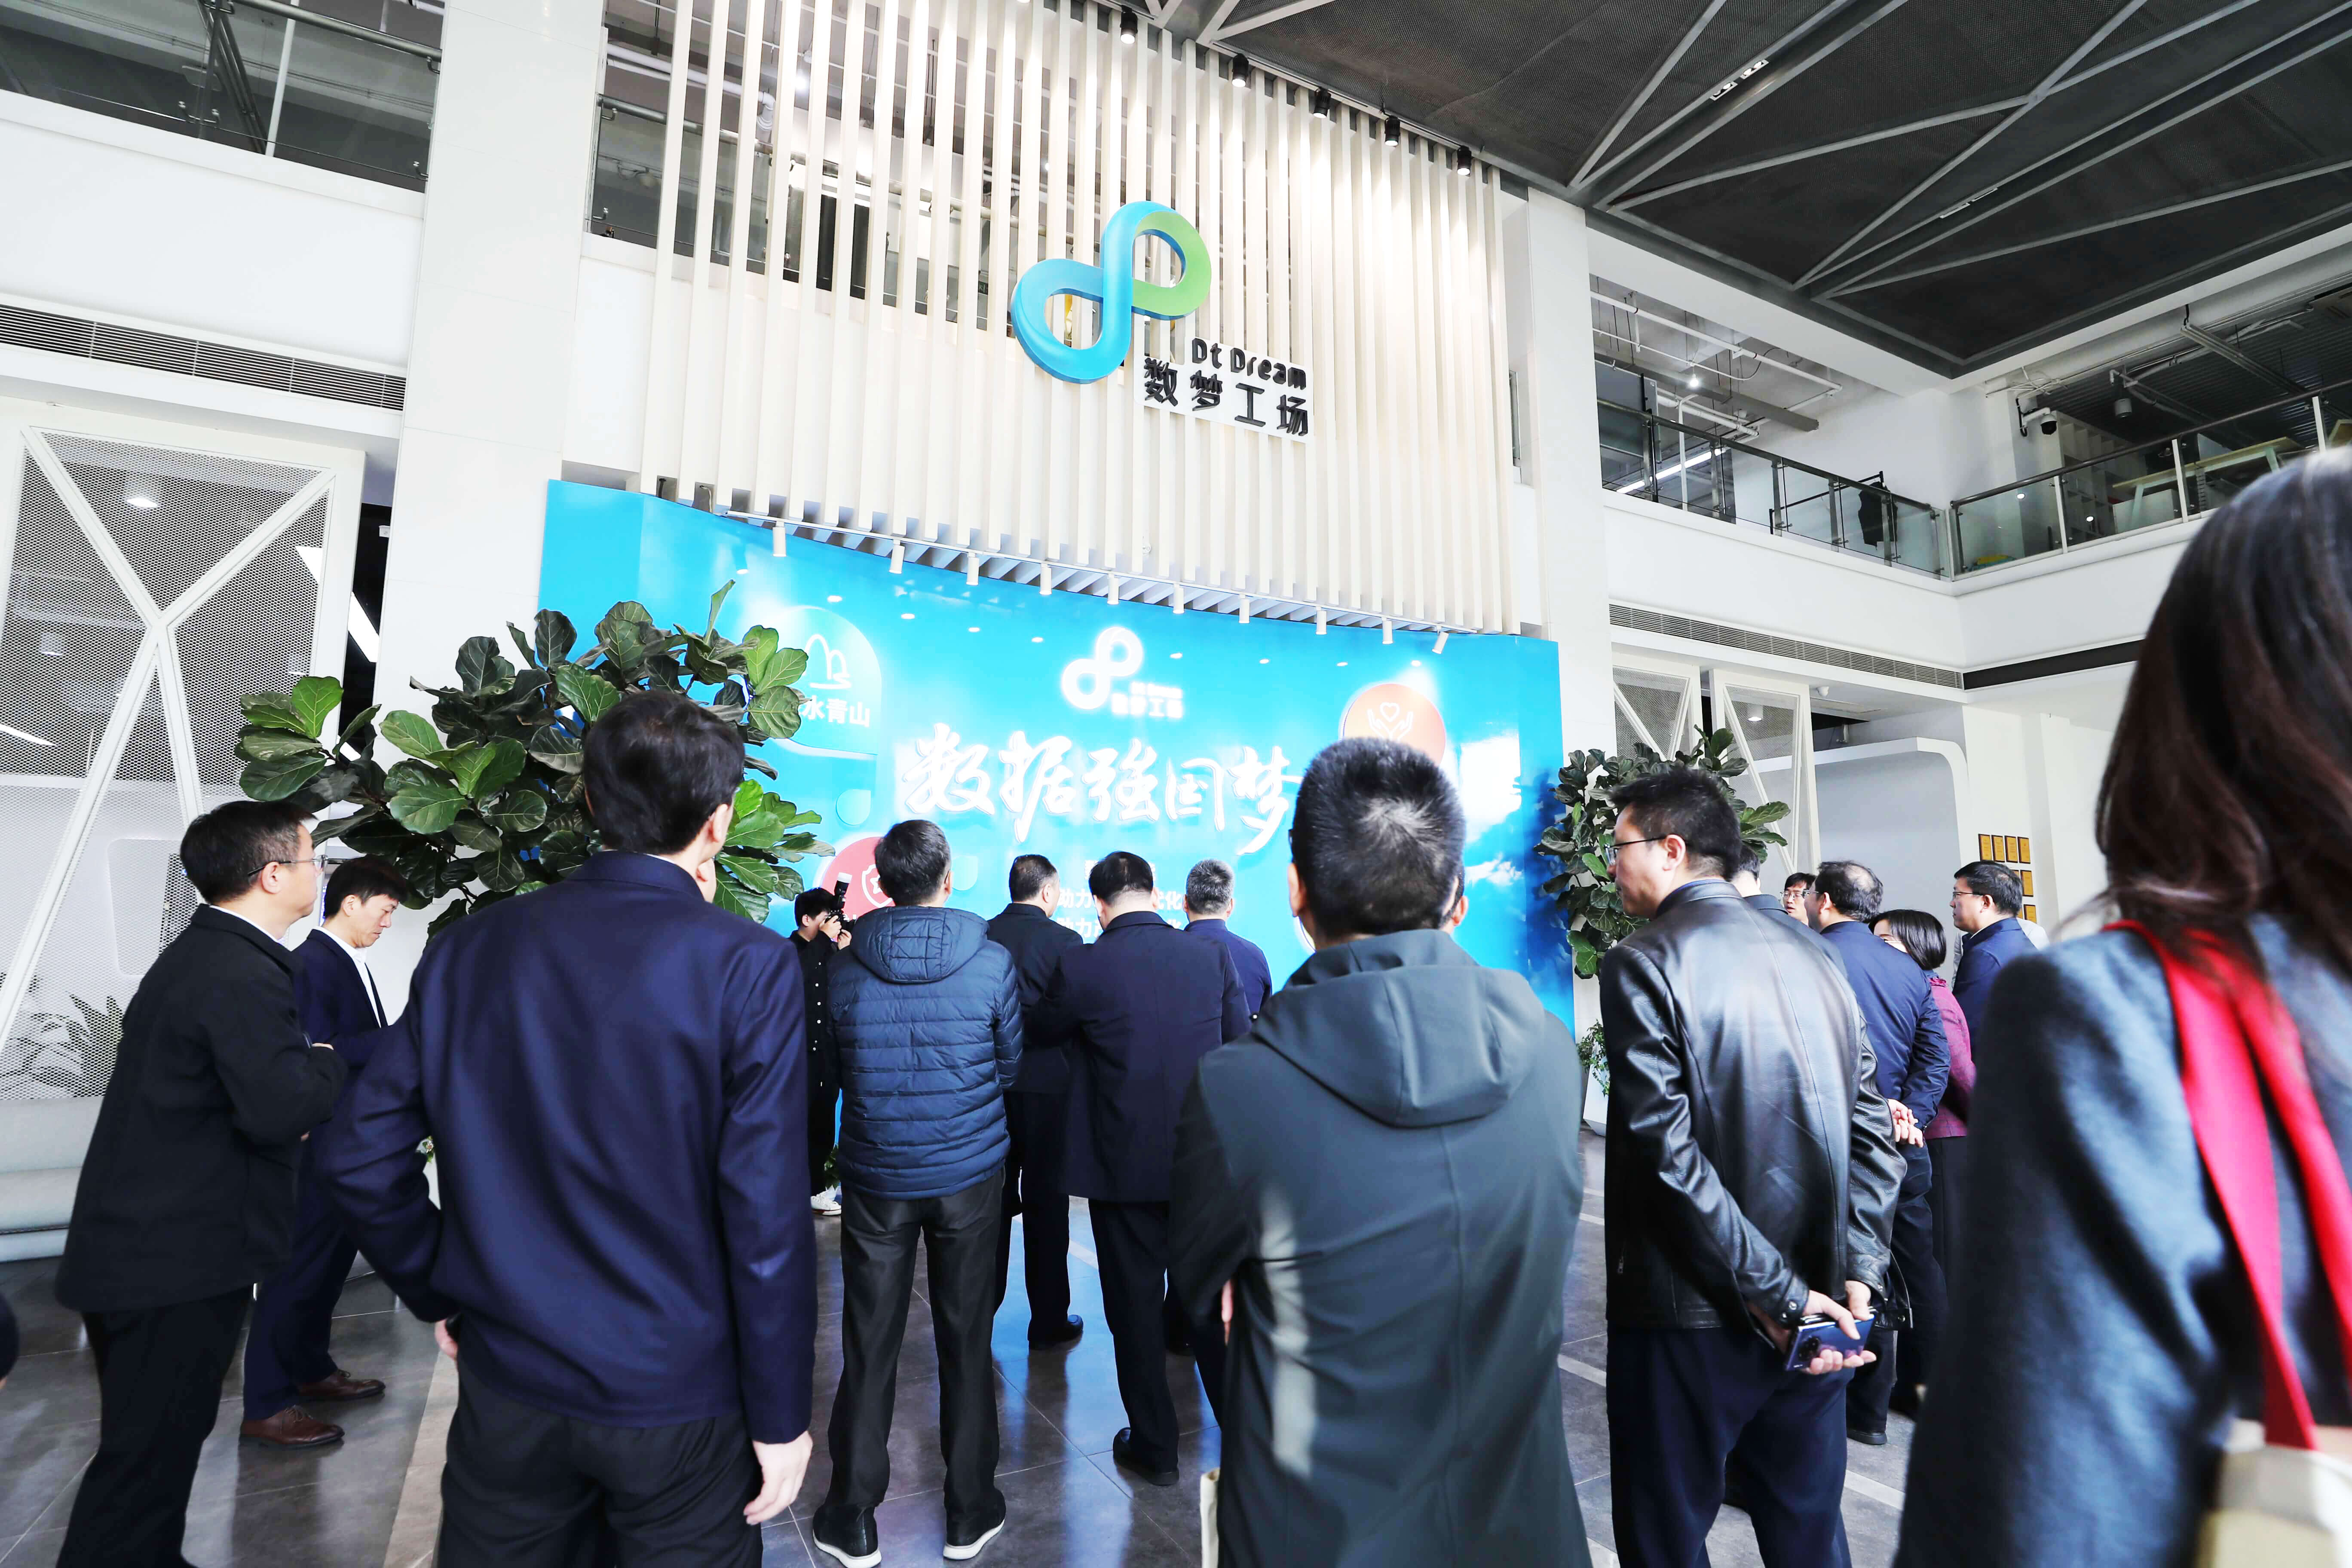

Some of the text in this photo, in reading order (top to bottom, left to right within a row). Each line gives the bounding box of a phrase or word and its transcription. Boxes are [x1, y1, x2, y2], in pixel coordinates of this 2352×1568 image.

[1143, 357, 1308, 436] 数梦工场
[1192, 338, 1307, 390] Dt Dream
[798, 694, 870, 728] 水青山
[903, 723, 1303, 855] 数据强国梦
